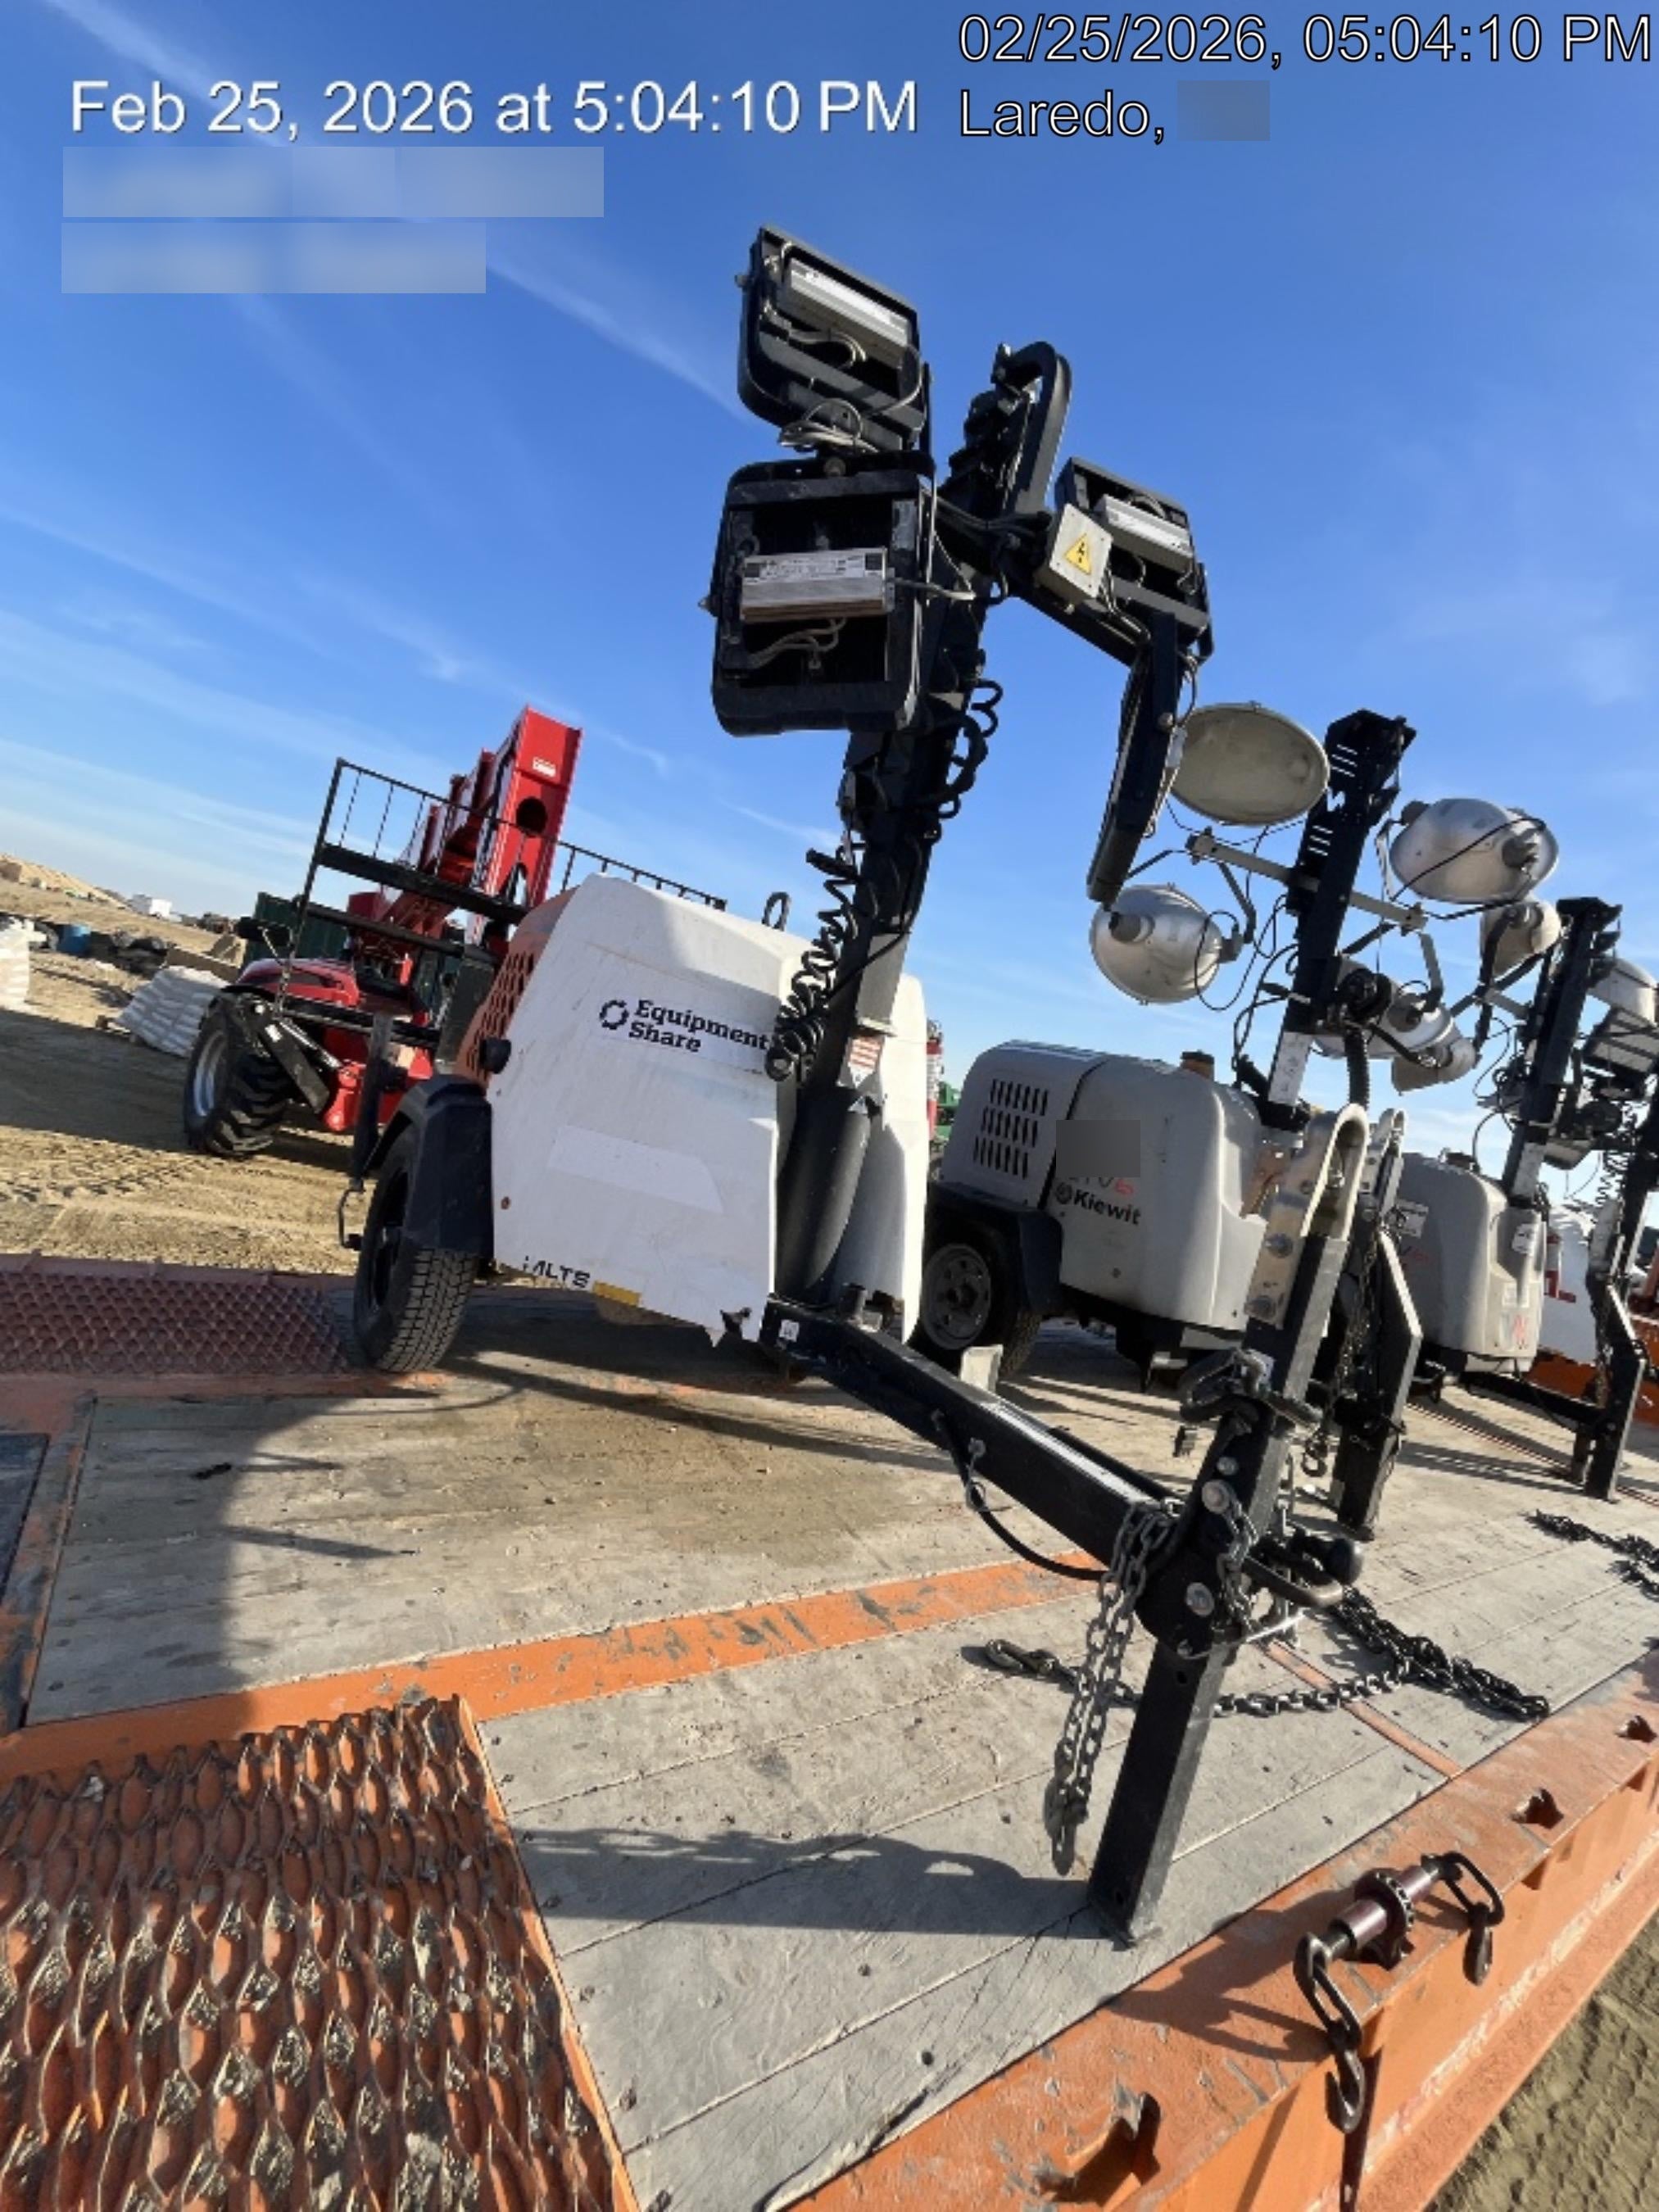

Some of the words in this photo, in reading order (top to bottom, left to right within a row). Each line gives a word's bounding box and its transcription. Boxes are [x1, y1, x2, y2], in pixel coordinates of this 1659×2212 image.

[628, 1021, 701, 1053] Share
[634, 999, 769, 1049] Equipment
[1072, 1189, 1141, 1226] Kiewit
